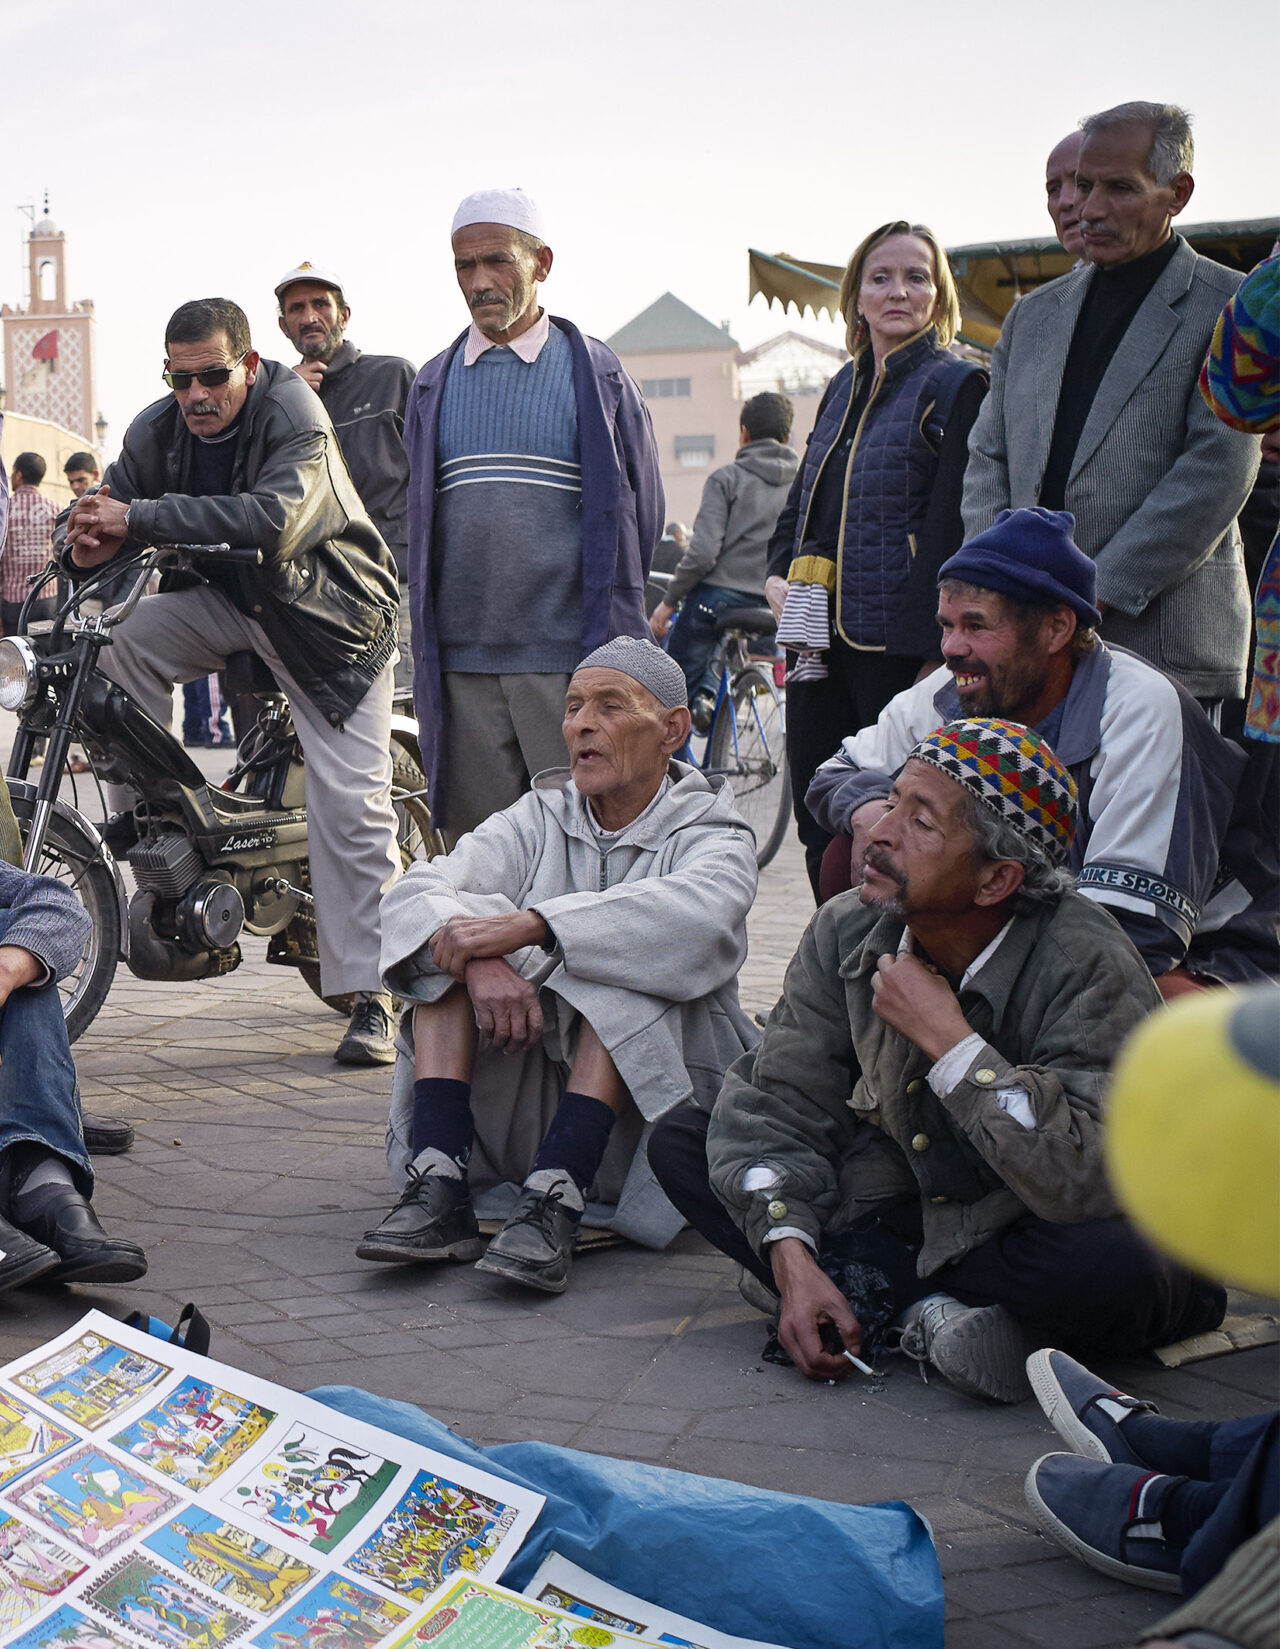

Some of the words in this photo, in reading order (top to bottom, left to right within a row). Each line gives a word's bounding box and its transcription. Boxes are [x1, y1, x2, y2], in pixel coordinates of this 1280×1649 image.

[221, 835, 260, 851] Laser
[1079, 867, 1119, 884] NIKE
[1120, 873, 1186, 912] SPORT
